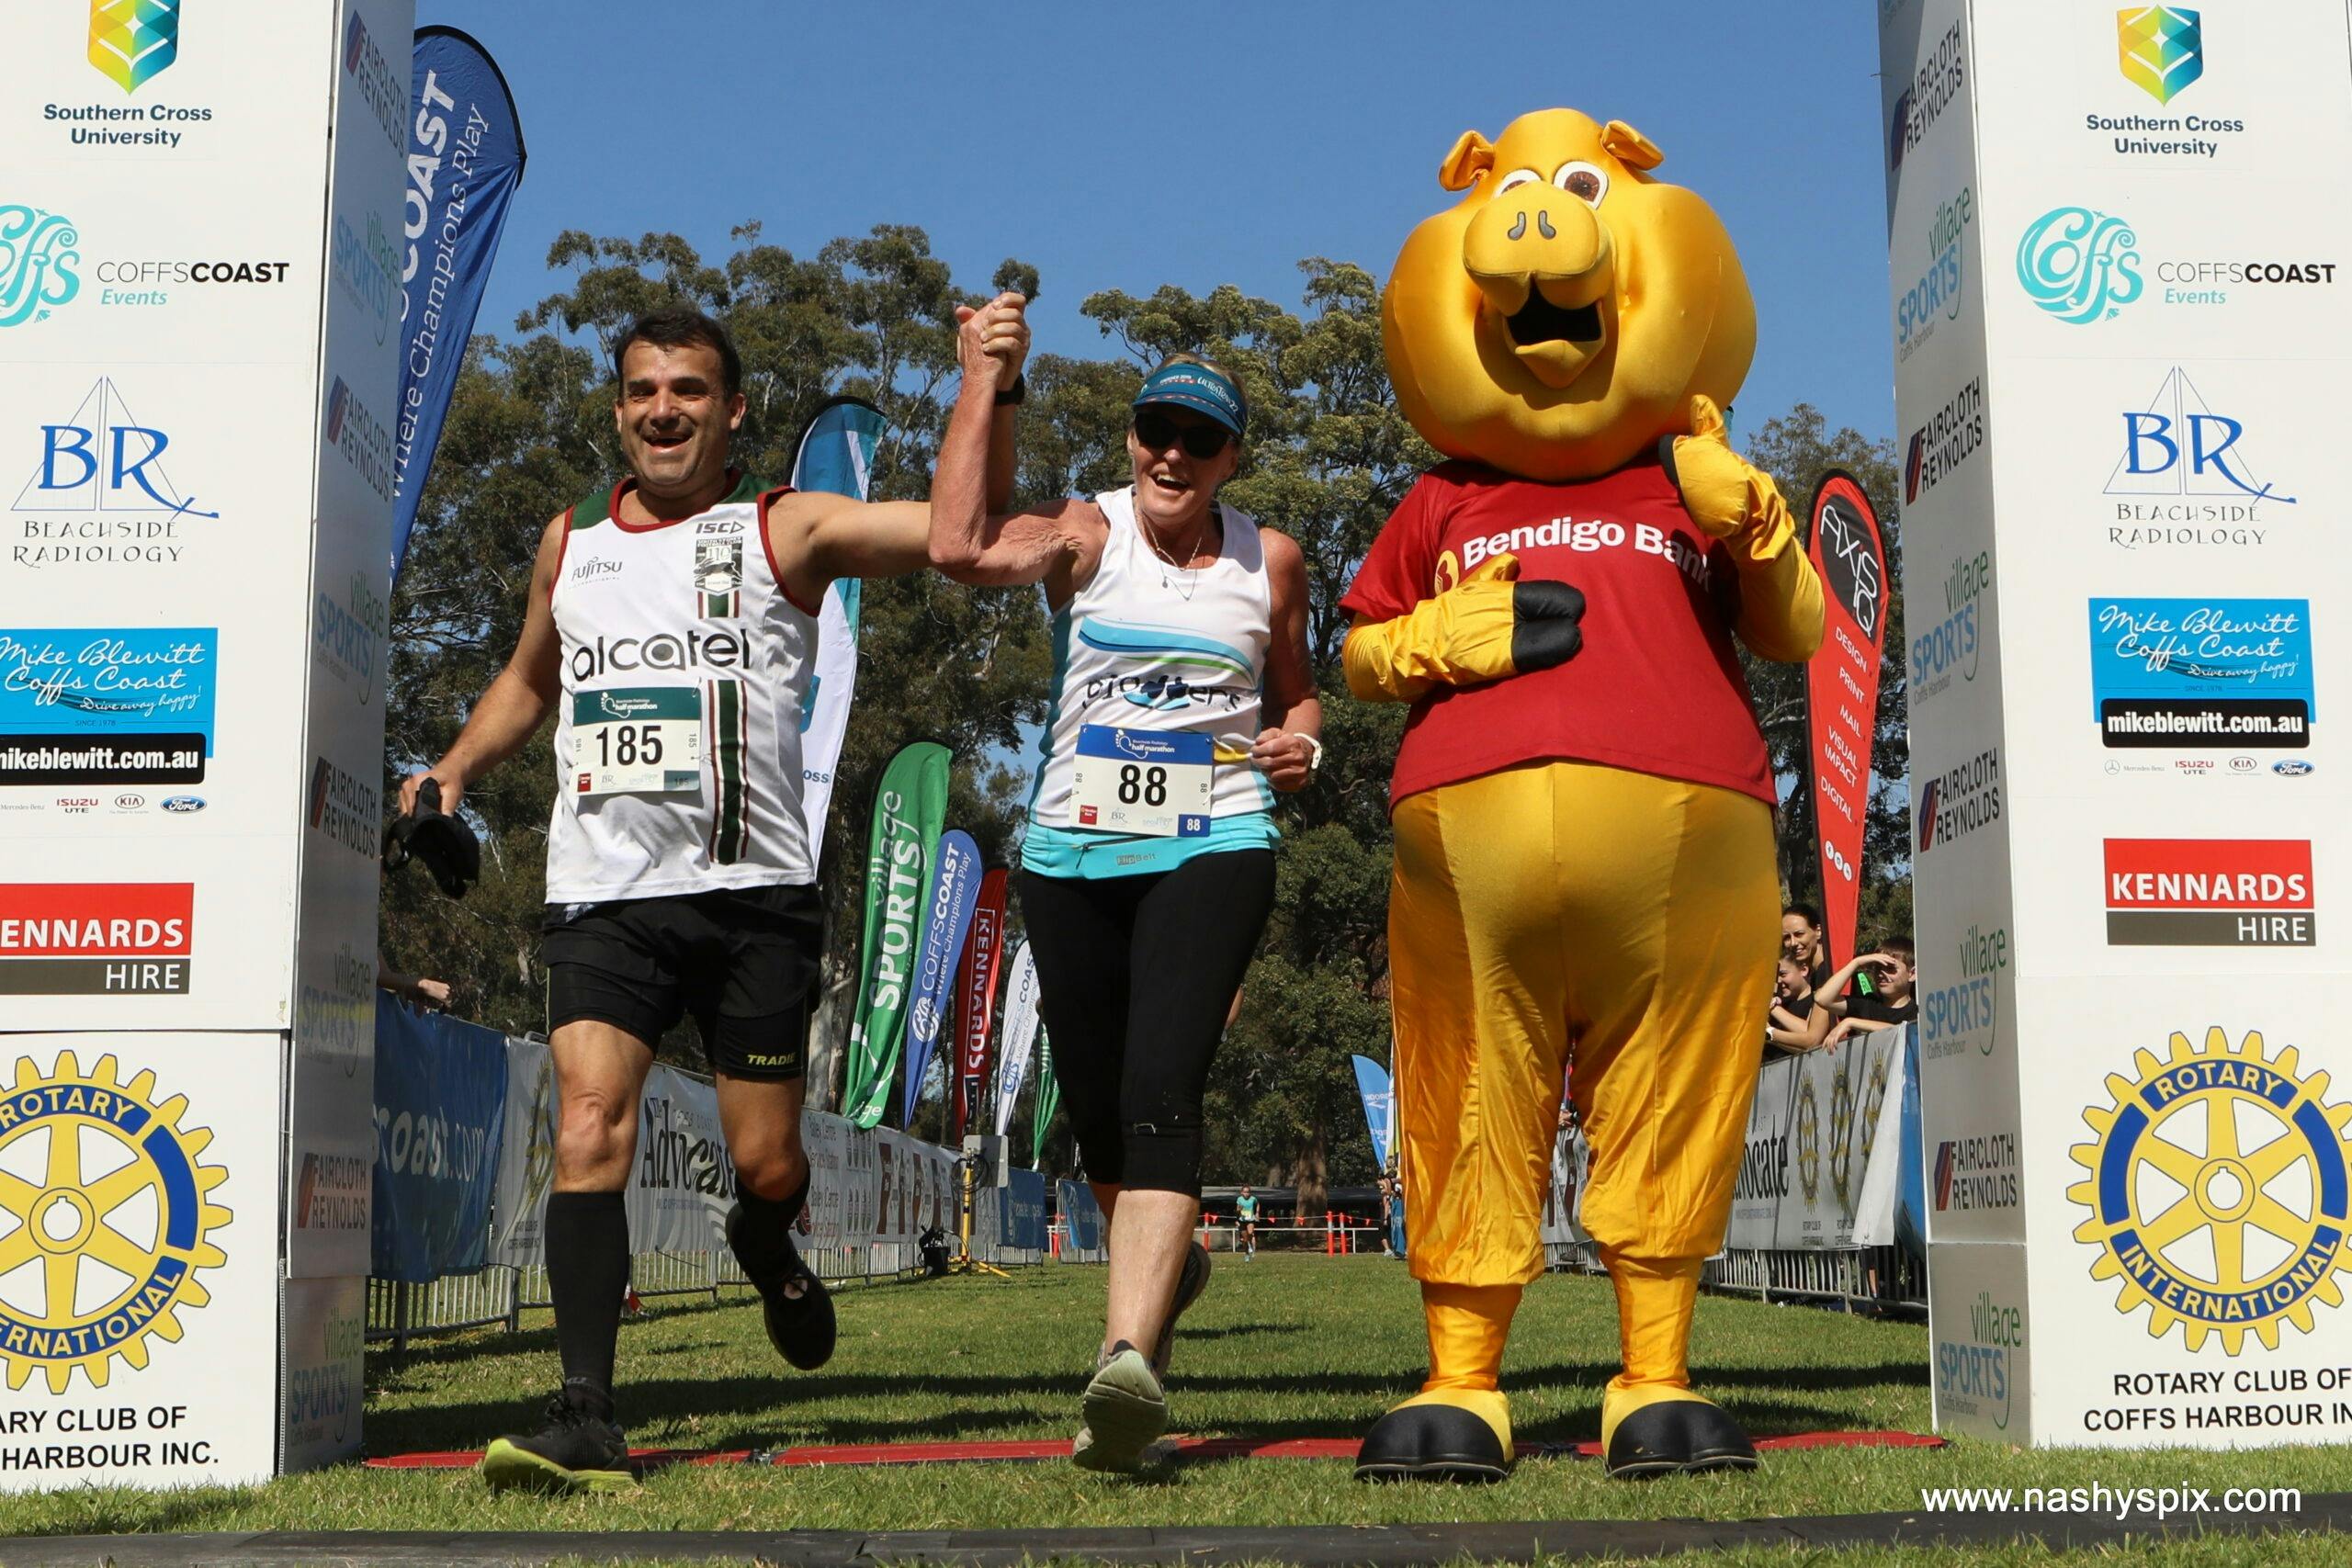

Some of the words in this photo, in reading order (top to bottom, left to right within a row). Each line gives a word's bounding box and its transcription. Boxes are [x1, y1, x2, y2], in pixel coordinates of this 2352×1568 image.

[360, 24, 406, 126] FAIRCLOTH
[1905, 19, 1961, 119] FAIRCLOTH
[43, 103, 145, 122] Southern
[150, 104, 213, 122] Cross
[358, 66, 404, 158] REYNOLDS
[1906, 56, 1963, 154] REYNOLDS
[2086, 114, 2180, 131] Southern
[2185, 116, 2244, 132] Cross
[70, 127, 182, 148] University
[2114, 138, 2218, 158] University
[411, 184, 467, 378] Champions
[452, 103, 490, 179] Play
[1928, 186, 1971, 262] village
[96, 262, 289, 284] COFFSCOAST
[336, 214, 387, 320] SPORTS
[2157, 262, 2336, 284] COFFSCOAST
[100, 288, 167, 306] Events
[1898, 243, 1959, 345] SPORTS
[2165, 288, 2226, 305] Events
[343, 382, 390, 464] FAIRCLOTH
[1920, 376, 1981, 457] FAIRCLOTH
[341, 428, 390, 502] REYNOLDS
[1922, 414, 1983, 493] REYNOLDS
[24, 520, 180, 539] BEACHSIDE
[695, 522, 731, 534] ISC
[2117, 503, 2260, 522] BEACHSIDE
[13, 547, 184, 569] RADIOLOGY
[1463, 516, 1625, 570] Bendigo
[2109, 527, 2267, 550] RADIOLOGY
[571, 557, 623, 581] FUJITSU
[1944, 550, 1989, 614] village
[317, 592, 370, 678] SPORTS
[2098, 604, 2177, 636] Mike
[2181, 608, 2300, 635] Blewitt
[77, 638, 206, 667] Blewitt
[571, 628, 750, 682] alcatel
[1836, 626, 1867, 673] DESIGN
[1912, 603, 1975, 687] SPORTS
[2115, 633, 2195, 672] Coffs
[2199, 634, 2284, 658] Coast
[5, 665, 89, 706] Coffs
[94, 666, 187, 692] Coast
[1839, 666, 1865, 704] PRINT
[2187, 663, 2224, 677] Drive
[2225, 668, 2258, 683] away
[2260, 654, 2300, 679] happy!
[80, 696, 119, 711] Drive
[120, 701, 155, 717] away
[158, 685, 202, 713] happy!
[74, 719, 96, 728] SINCE
[688, 733, 697, 748] 185
[1840, 705, 1860, 738] MAIL
[2108, 712, 2303, 733] mikeblewitt.com.au
[596, 725, 663, 766] 185
[1144, 745, 1175, 753] marathon
[1828, 725, 1858, 771] VISUAL
[2176, 761, 2214, 769] ISUZU
[1075, 773, 1082, 783] 88
[1825, 743, 1857, 788] IMPACT
[1934, 747, 1997, 808] FAIRCLOTH
[2279, 761, 2306, 775] Ford
[56, 798, 98, 807] ISUZU
[119, 797, 140, 806] KIA
[169, 797, 198, 812] Ford
[325, 762, 377, 822] FAIRCLOTH
[1118, 764, 1168, 807] 88
[1200, 783, 1207, 793] 88
[1821, 775, 1853, 823] DIGITAL
[323, 802, 375, 860] REYNOLDS
[1186, 818, 1201, 831] 88
[1936, 787, 1999, 845] REYNOLDS
[871, 790, 902, 907] village
[942, 882, 964, 953] Champions
[957, 852, 972, 879] Play
[2112, 873, 2307, 902] KENNARDS
[870, 838, 921, 1010] SPORTS
[922, 841, 960, 991] COFFSCOAST
[2237, 917, 2307, 942] HIRE
[1960, 925, 2007, 979] village
[105, 964, 181, 989] HIRE
[966, 917, 995, 1069] KENNARDS
[302, 984, 356, 1051] SPORTS
[1926, 976, 1992, 1041] SPORTS
[2154, 1063, 2283, 1102] ROTARY
[0, 1088, 135, 1129] ROTARY
[640, 1097, 738, 1201] Advocat
[1951, 1133, 2015, 1173] FAIRCLOTH
[312, 1158, 367, 1190] FAIRCLOTH
[1952, 1173, 2018, 1211] REYNOLDS
[312, 1195, 366, 1229] REYNOLDS
[2120, 1240, 2337, 1320] INTERNATIONAL
[1971, 1292, 2021, 1348] village
[1939, 1341, 2005, 1401] SPORTS
[2114, 1371, 2225, 1396] ROTARY
[2233, 1369, 2308, 1393] CLUB
[2317, 1367, 2352, 1390] OF
[291, 1363, 347, 1425] SPORTS
[56, 1407, 136, 1432] CLUB
[147, 1405, 187, 1429] OF
[2084, 1407, 2176, 1431] COFFS
[2186, 1403, 2324, 1428] HARBOUR
[3, 1443, 152, 1471] HARBOUR
[161, 1440, 219, 1465] INC.
